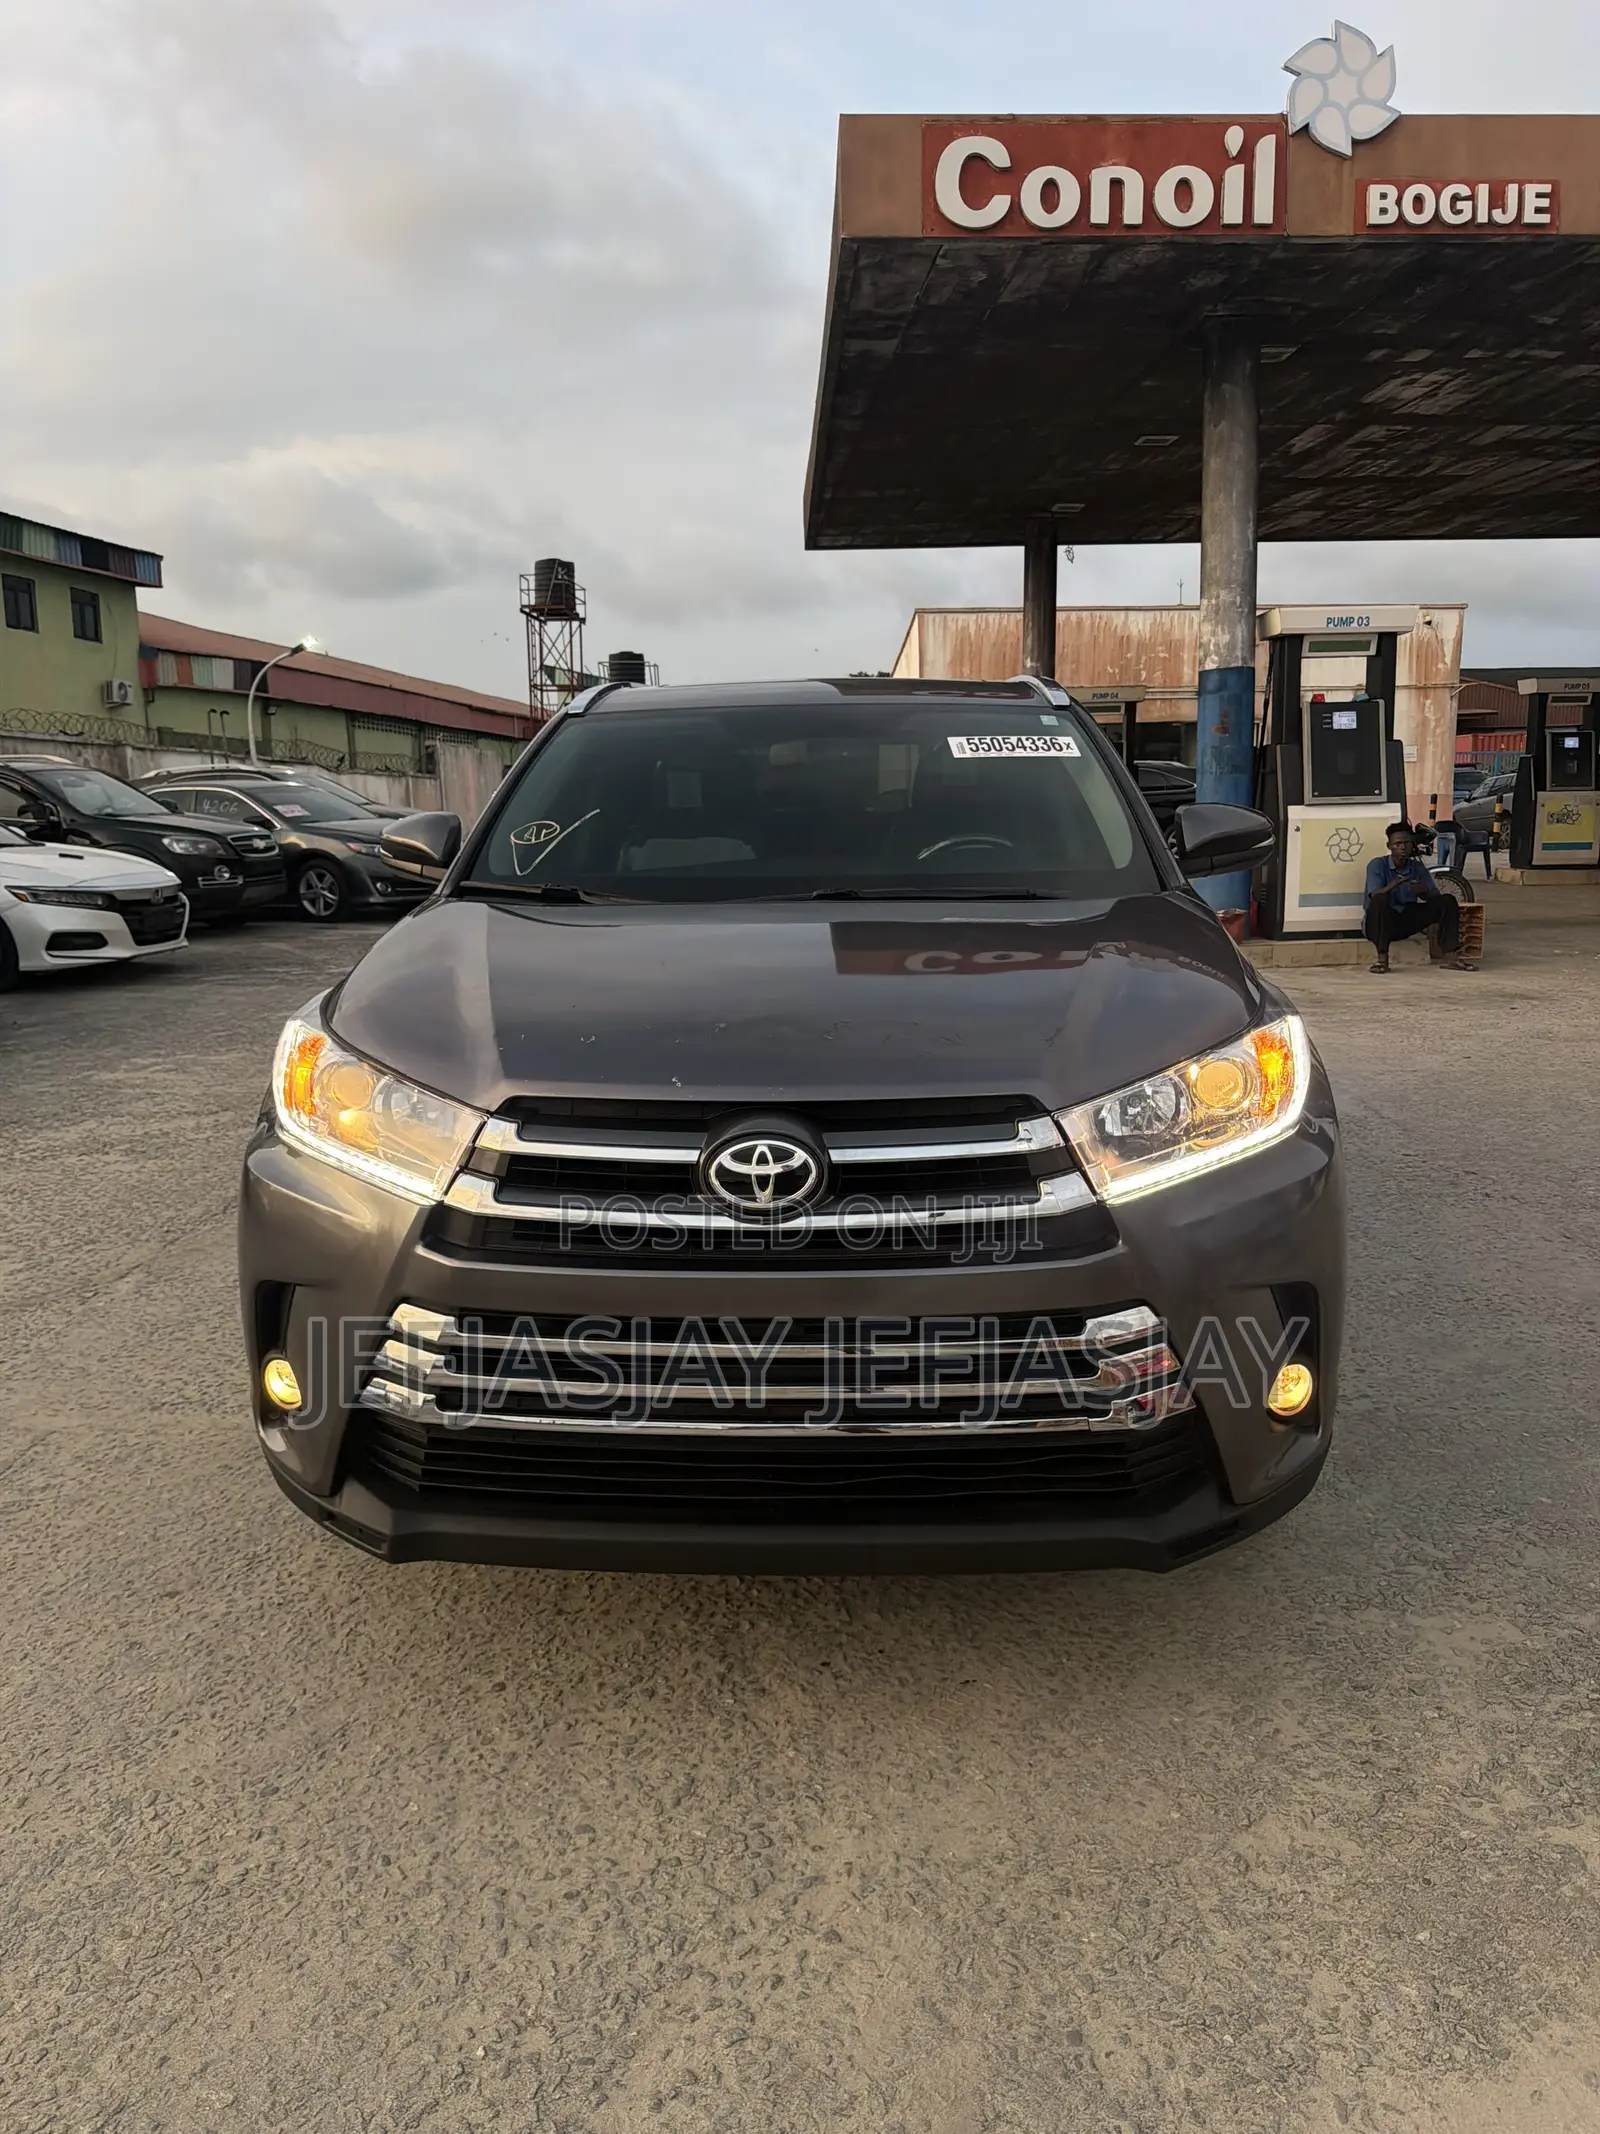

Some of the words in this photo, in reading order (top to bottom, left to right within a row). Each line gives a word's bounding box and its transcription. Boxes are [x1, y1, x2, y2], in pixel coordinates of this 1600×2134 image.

[934, 124, 1277, 230] Conoil
[1366, 183, 1552, 226] BOGIJE
[1326, 616, 1355, 628] PUMP
[1356, 615, 1371, 627] 03
[1563, 682, 1581, 690] PUMP
[1091, 692, 1109, 700] PUMP
[1110, 691, 1119, 699] 04
